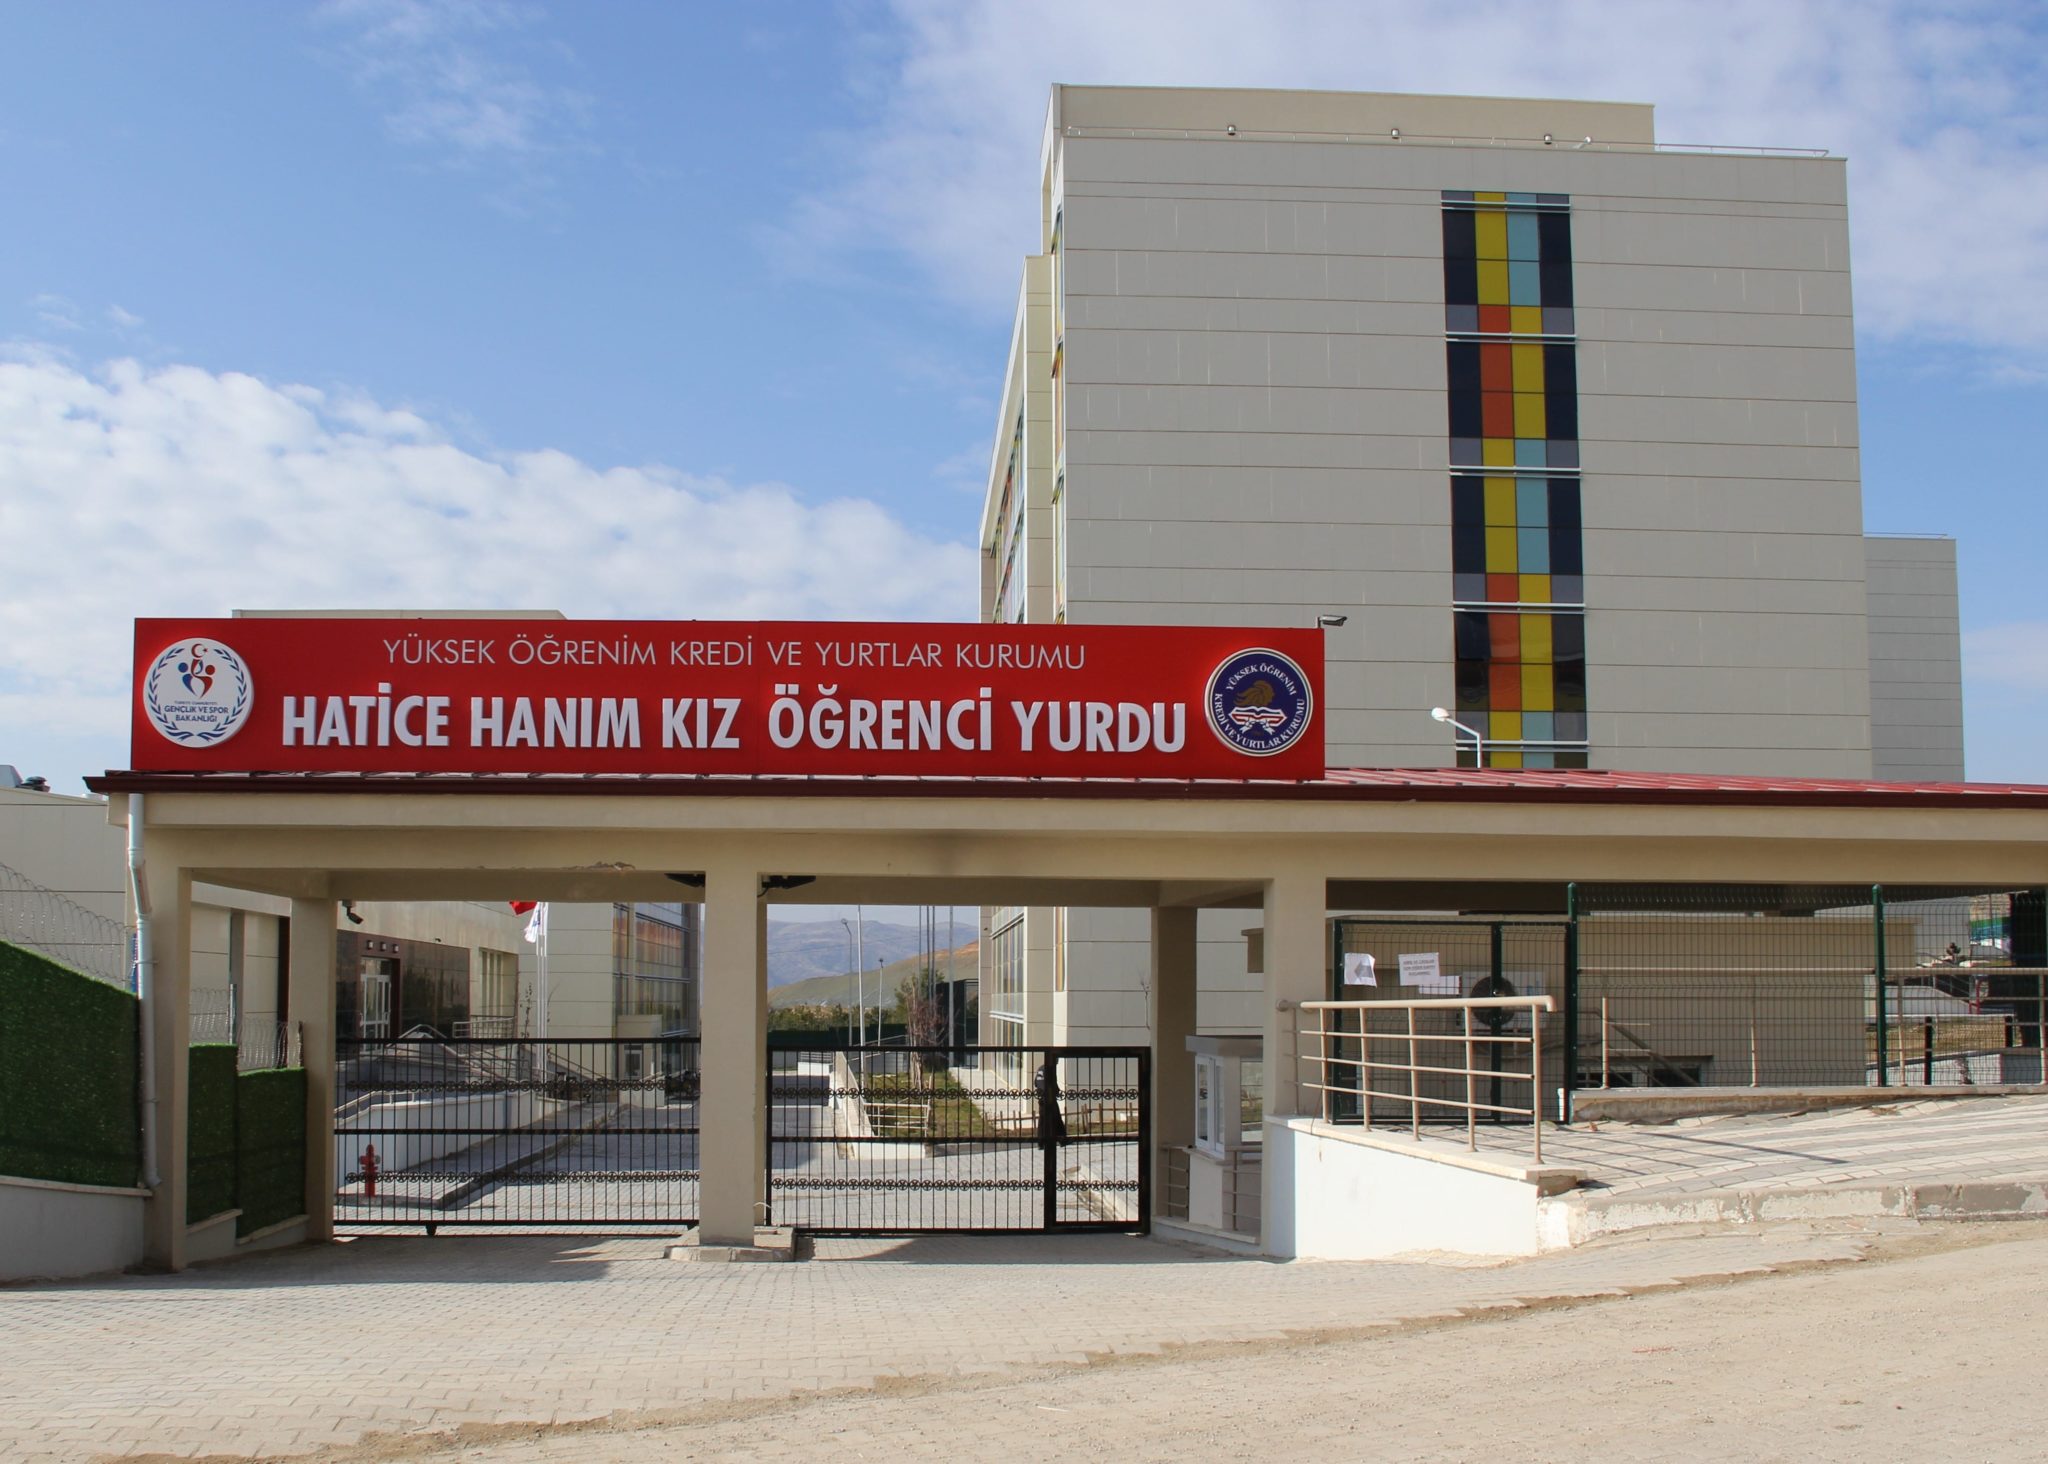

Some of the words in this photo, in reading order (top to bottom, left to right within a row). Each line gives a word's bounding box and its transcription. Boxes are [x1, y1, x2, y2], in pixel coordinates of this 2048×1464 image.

[383, 633, 496, 664] YÜKSEK
[508, 633, 656, 665] ÖĞRENİM
[671, 635, 753, 666] KREDİ
[767, 641, 802, 666] VE
[815, 642, 943, 669] YURTLAR
[956, 643, 1085, 670] KURUMU
[1226, 664, 1258, 691] YÜKSEK
[1260, 663, 1297, 695] ÖĞRENİM
[208, 706, 229, 714] SPOR
[283, 682, 449, 747] HATİCE
[471, 696, 640, 748] HANIM
[663, 698, 741, 749] KIZ
[769, 683, 991, 751] ÖĞRENCİ
[1011, 701, 1186, 753] YURDU
[1224, 724, 1237, 738] VE
[1236, 734, 1281, 749] YURTLAR
[1280, 699, 1305, 741] KURUMU
